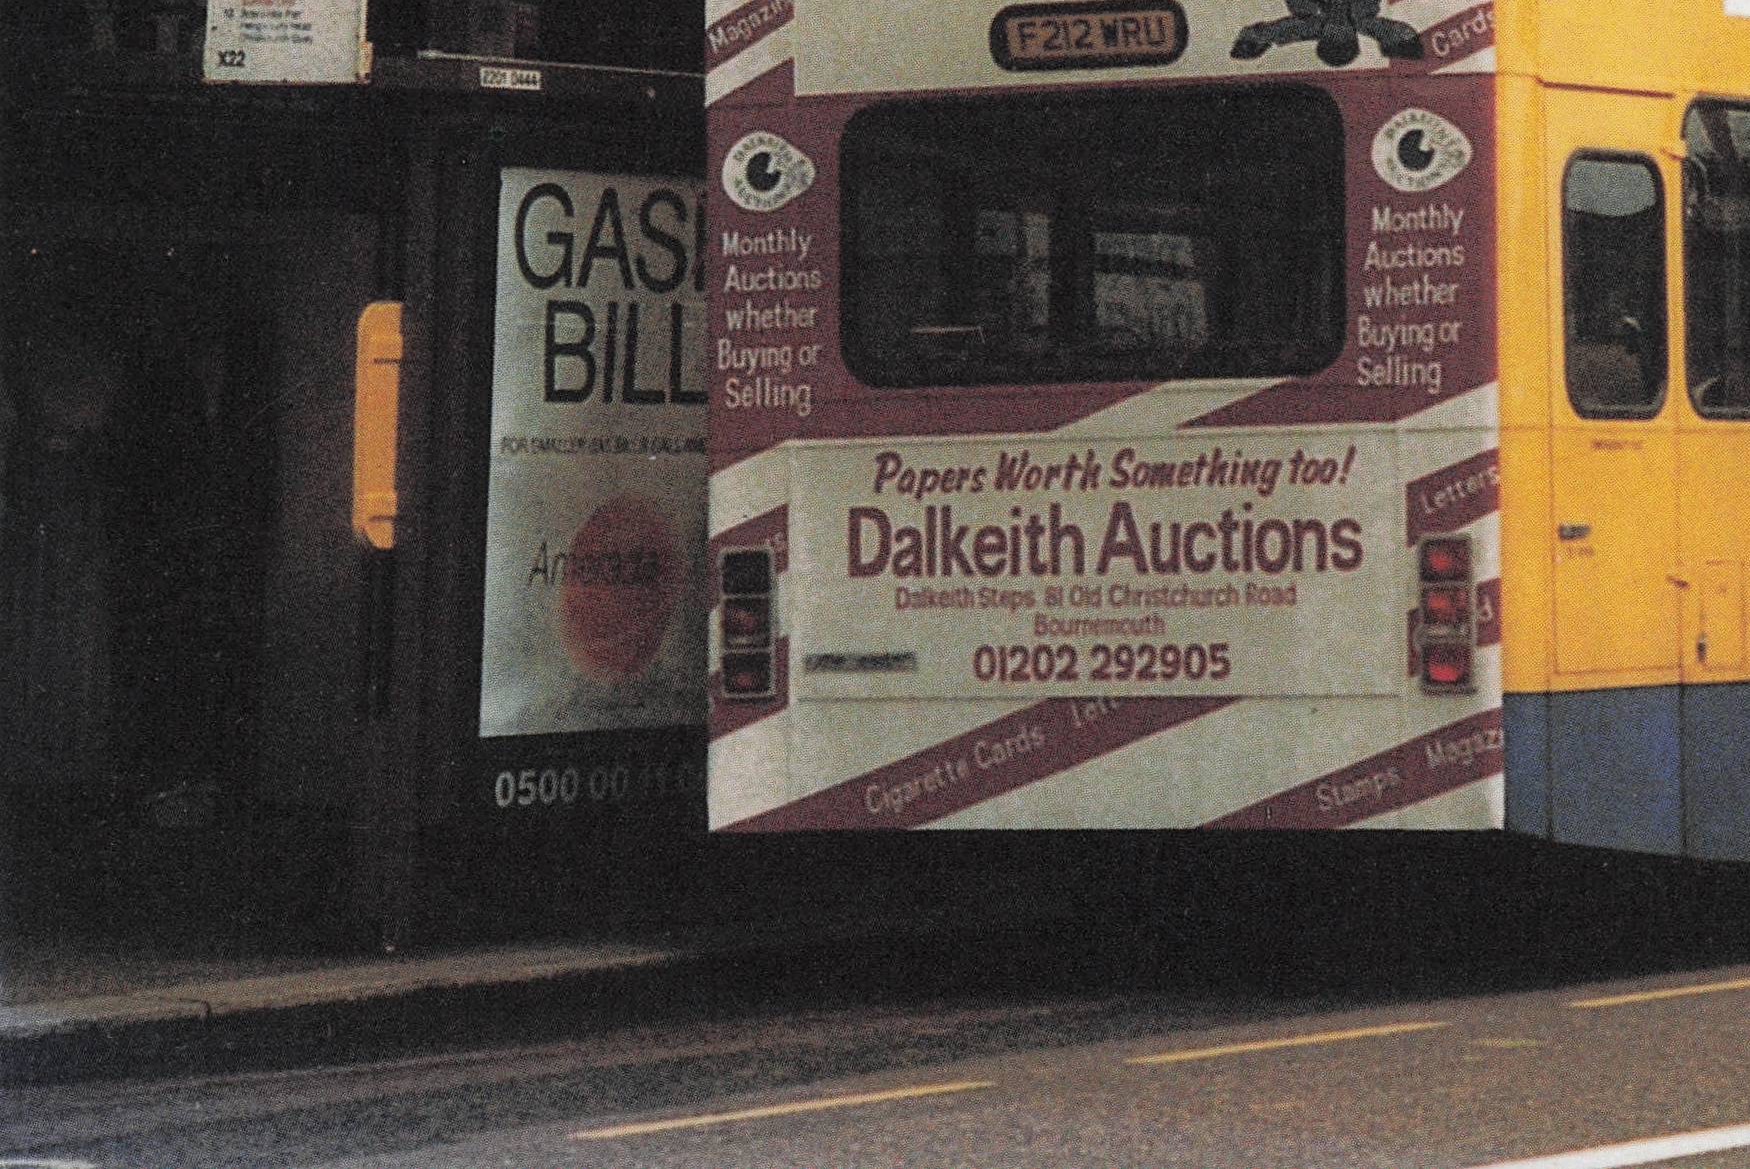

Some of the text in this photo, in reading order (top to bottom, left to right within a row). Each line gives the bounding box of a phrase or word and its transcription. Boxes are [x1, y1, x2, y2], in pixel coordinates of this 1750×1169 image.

[1372, 203, 1464, 235] Monthly
[722, 229, 812, 260] Monthly
[1364, 241, 1465, 271] Auctions
[723, 264, 824, 293] Auctions
[1364, 274, 1459, 309] whether
[726, 301, 817, 331] whether
[1358, 314, 1463, 353] Buying or
[718, 338, 822, 376] Buying or
[1357, 356, 1442, 394] Selling
[725, 377, 812, 417] Selling
[873, 444, 1357, 501] Papers Worth Something too!
[847, 501, 1365, 578] Dalkeith Auctions
[1068, 583, 1099, 607] Old
[1108, 582, 1239, 608] Christchurch
[1246, 582, 1297, 607] Road
[1034, 611, 1167, 638] Bournemouth
[974, 642, 1232, 682] 01202 292905
[494, 766, 580, 809] 0500
[589, 765, 629, 800] 00
[864, 728, 1044, 816] Cigarette Cards
[1315, 768, 1400, 813] Stamps
